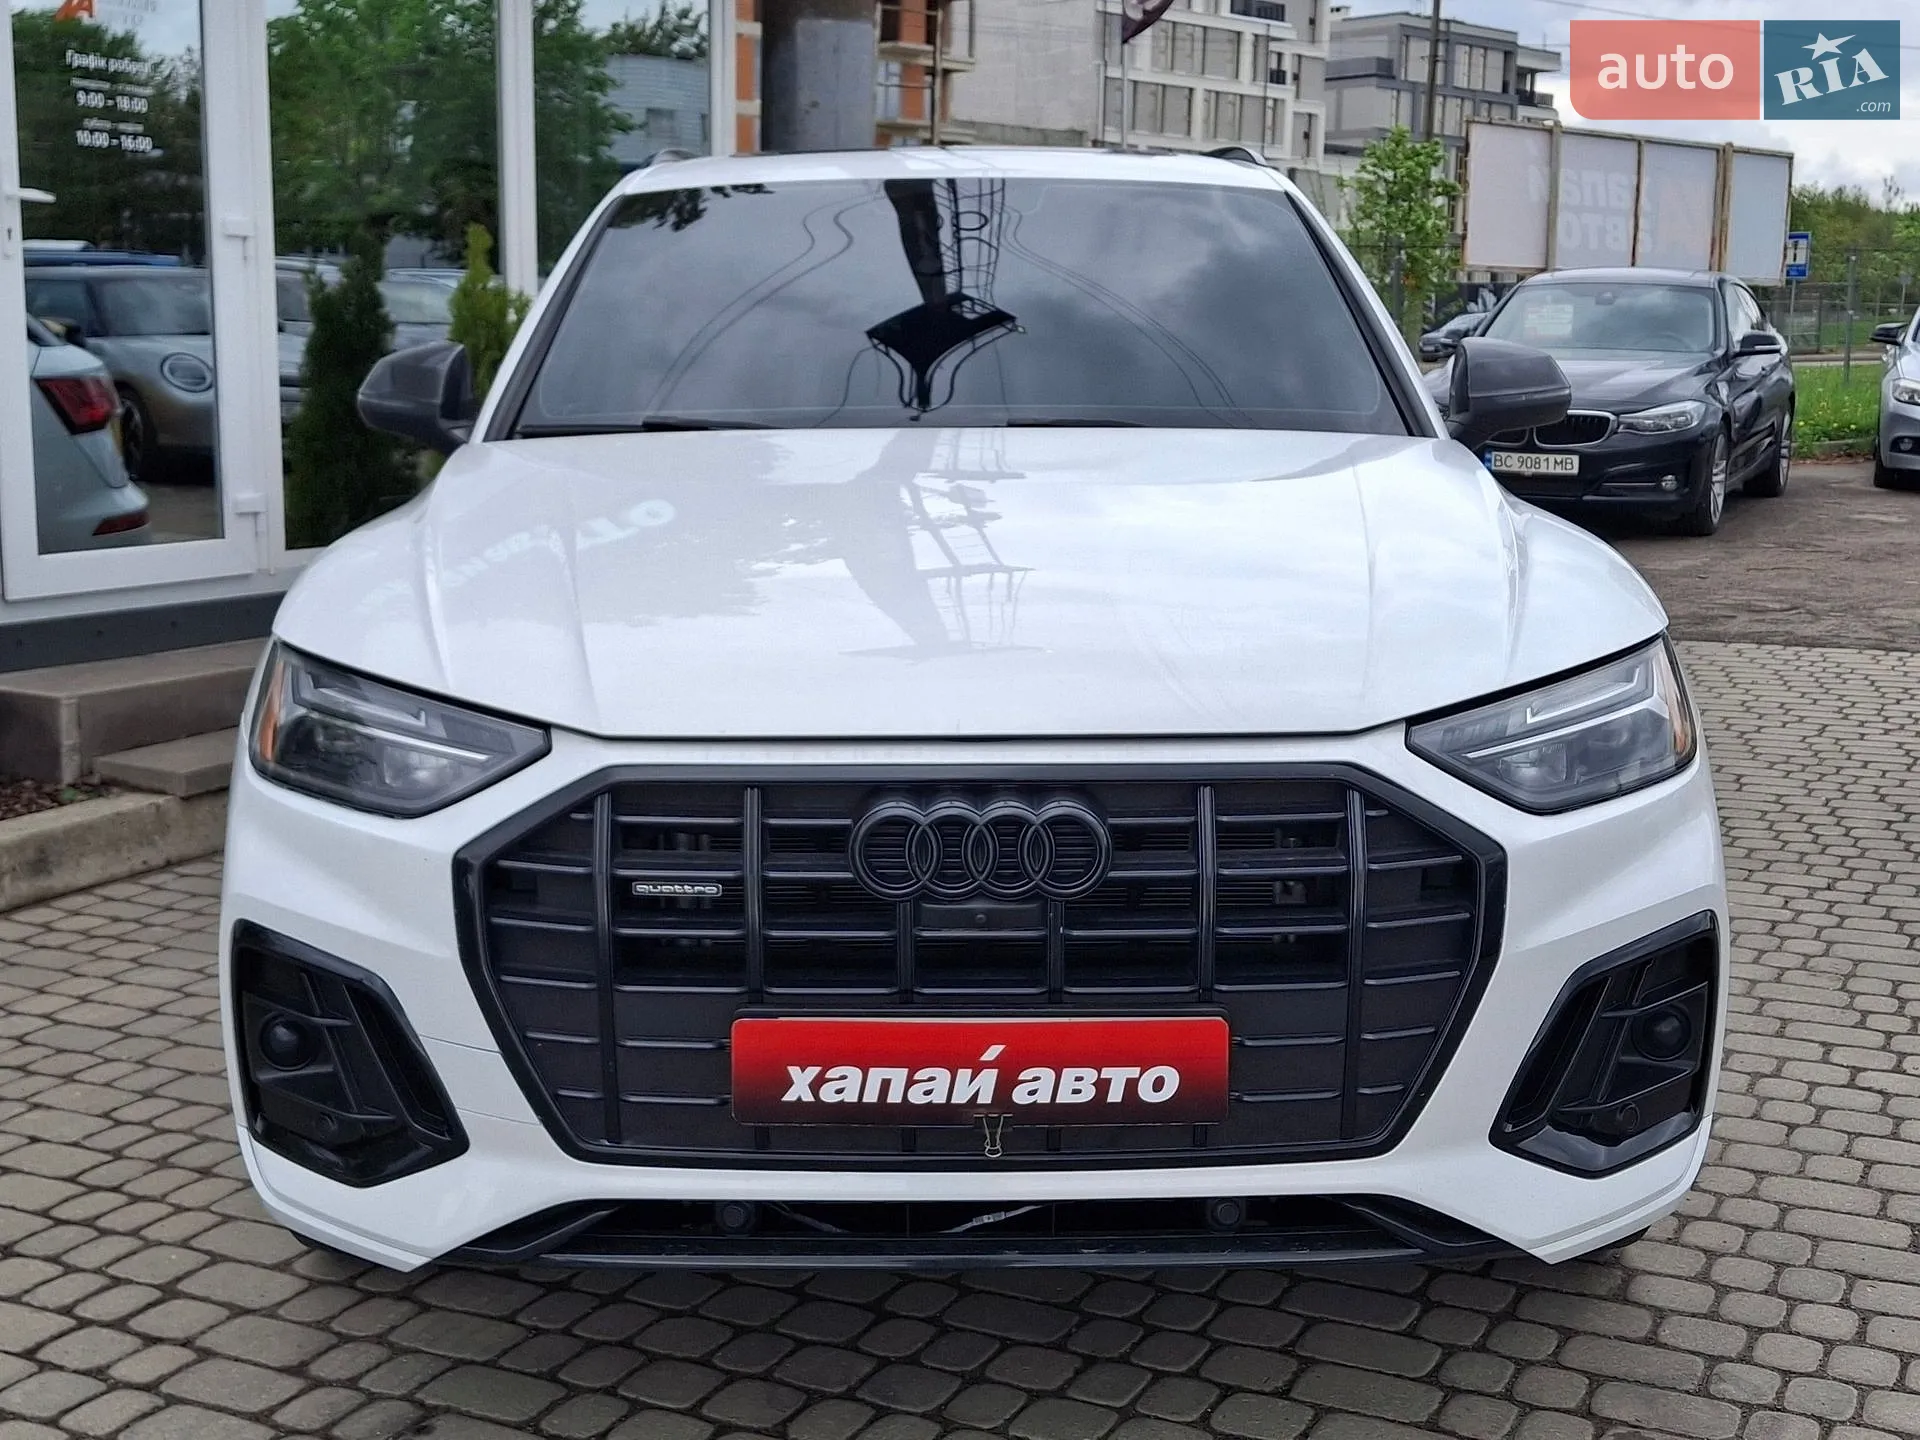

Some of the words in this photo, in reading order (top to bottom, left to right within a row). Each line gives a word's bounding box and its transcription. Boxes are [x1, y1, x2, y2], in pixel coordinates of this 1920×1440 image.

[76, 90, 105, 108] 9:00
[1494, 454, 1513, 468] BC
[1517, 456, 1549, 470] 9081
[1553, 457, 1574, 471] MB
[635, 884, 718, 894] quattro
[1011, 1064, 1181, 1104] авто
